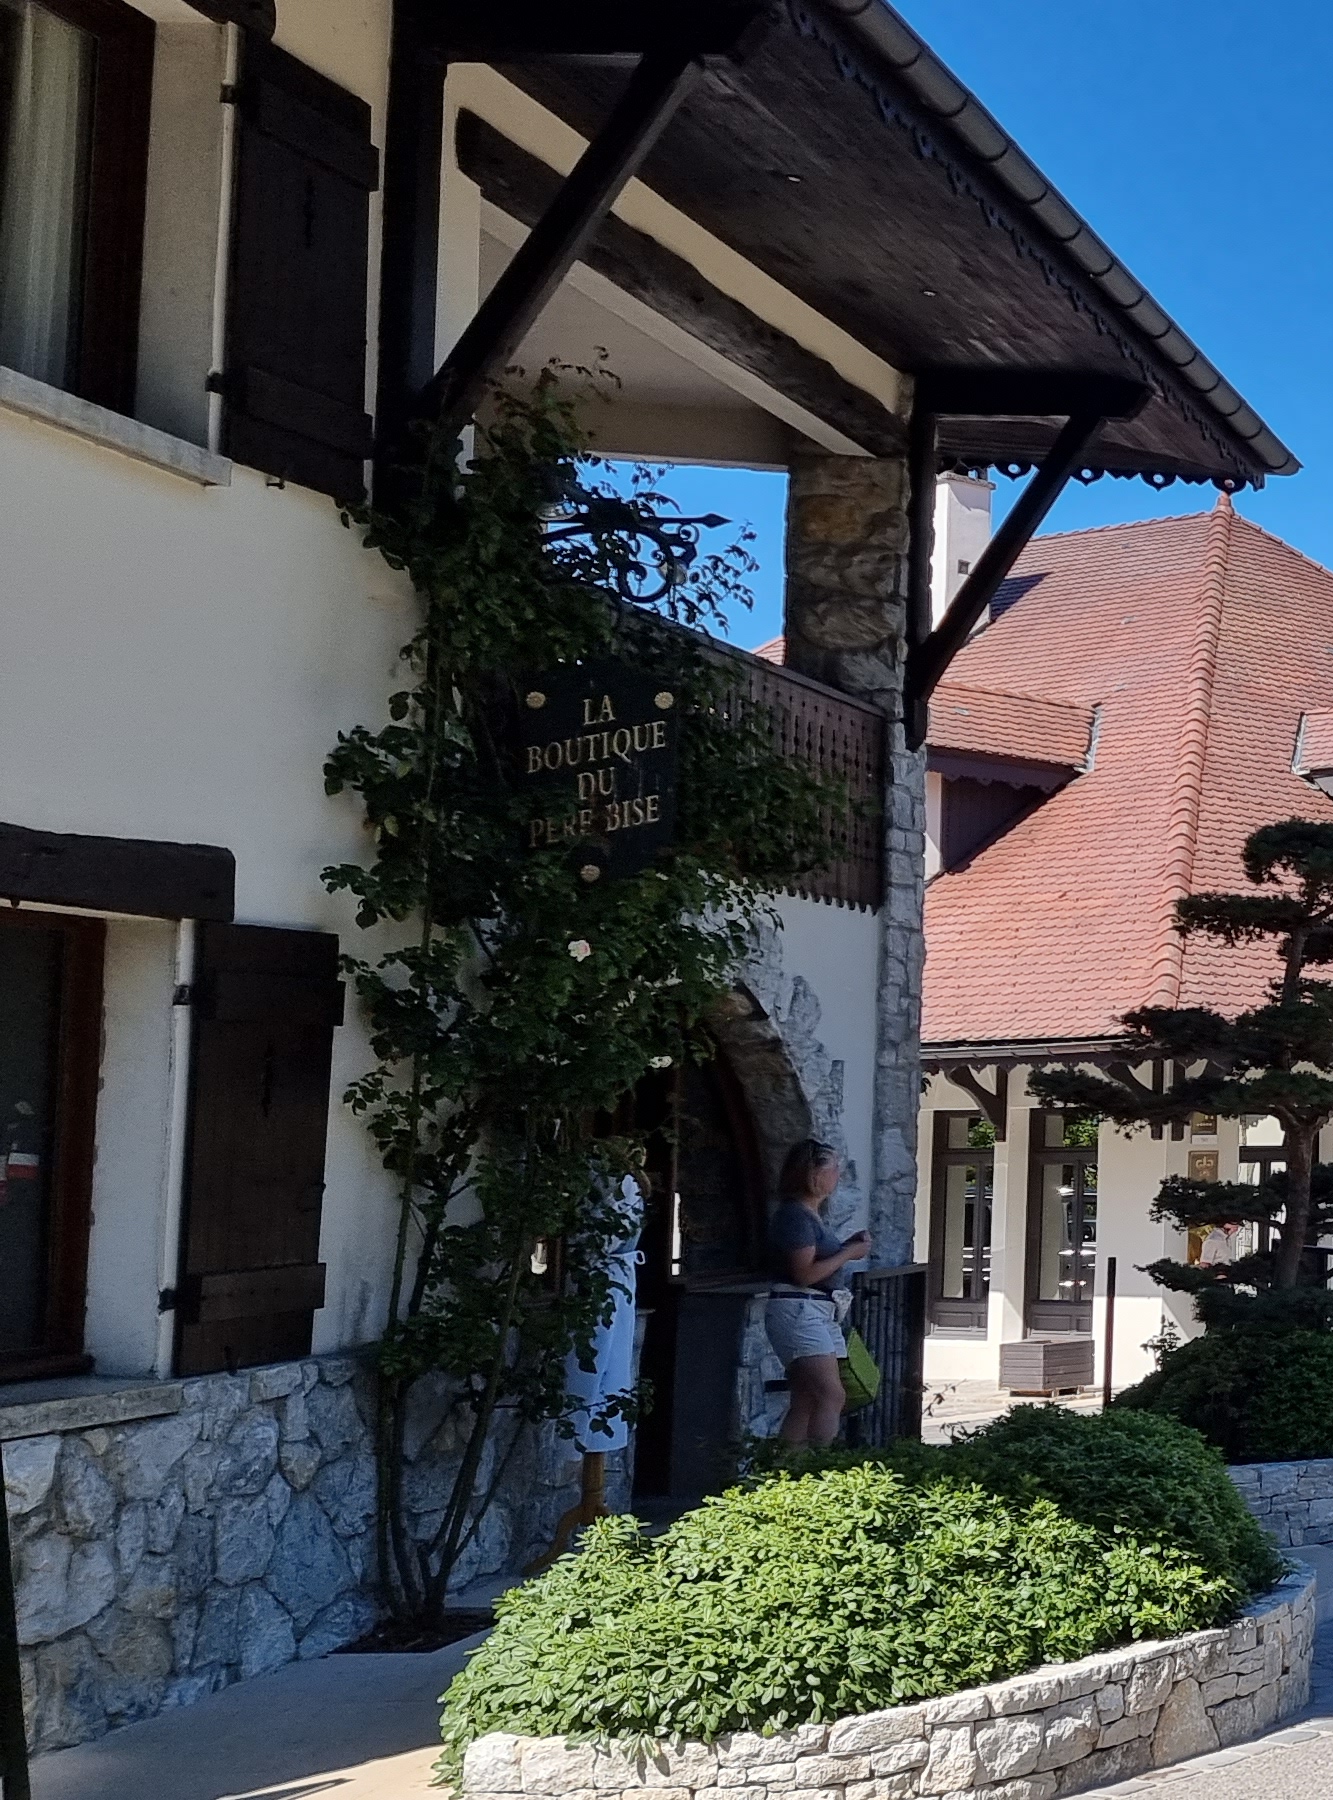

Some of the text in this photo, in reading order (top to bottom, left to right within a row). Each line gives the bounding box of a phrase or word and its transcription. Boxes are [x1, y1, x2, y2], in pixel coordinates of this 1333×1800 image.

[583, 695, 616, 726] LA
[527, 721, 667, 774] BOUTIQUE
[577, 766, 616, 800] DU
[606, 794, 661, 832] BISE
